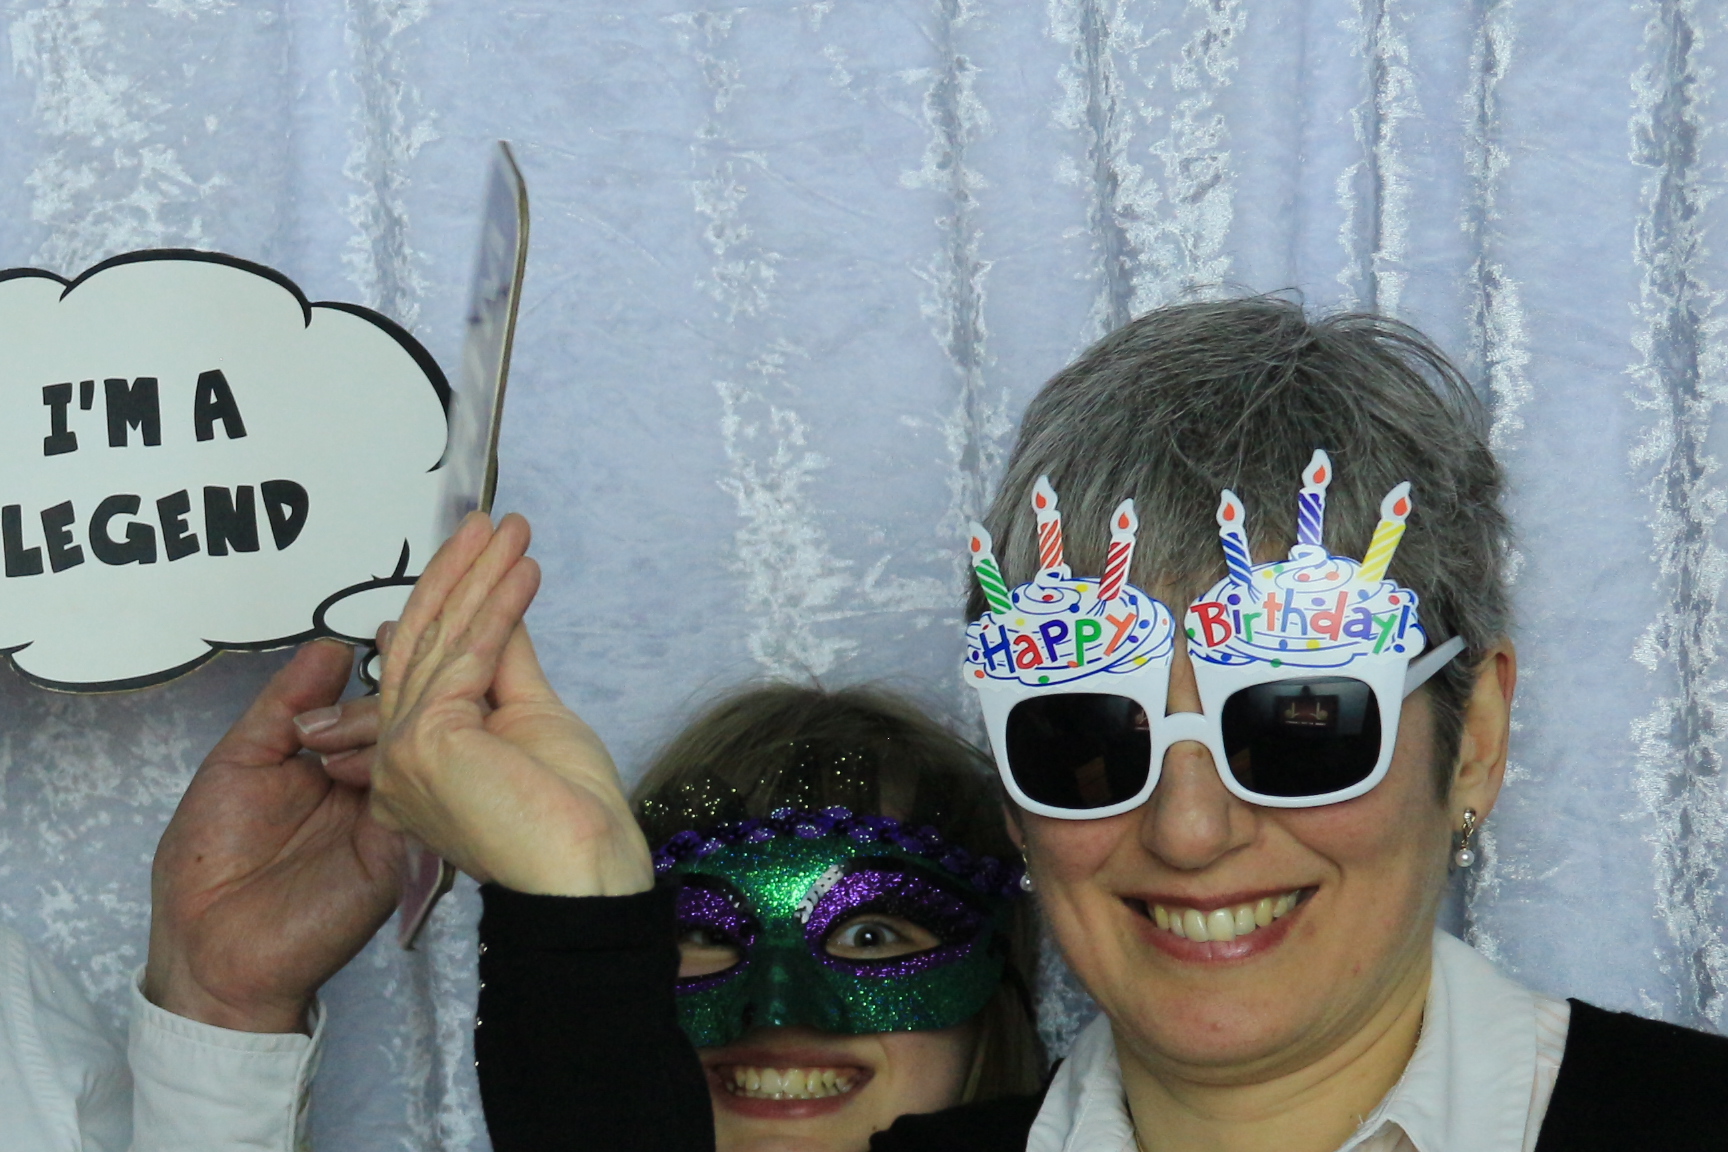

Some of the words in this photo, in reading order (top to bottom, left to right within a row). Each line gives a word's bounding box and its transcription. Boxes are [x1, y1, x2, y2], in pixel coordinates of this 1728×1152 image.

[42, 376, 162, 457] I'M
[193, 369, 248, 443] A
[0, 478, 310, 579] LEGEND
[1189, 587, 1411, 655] Birthday!
